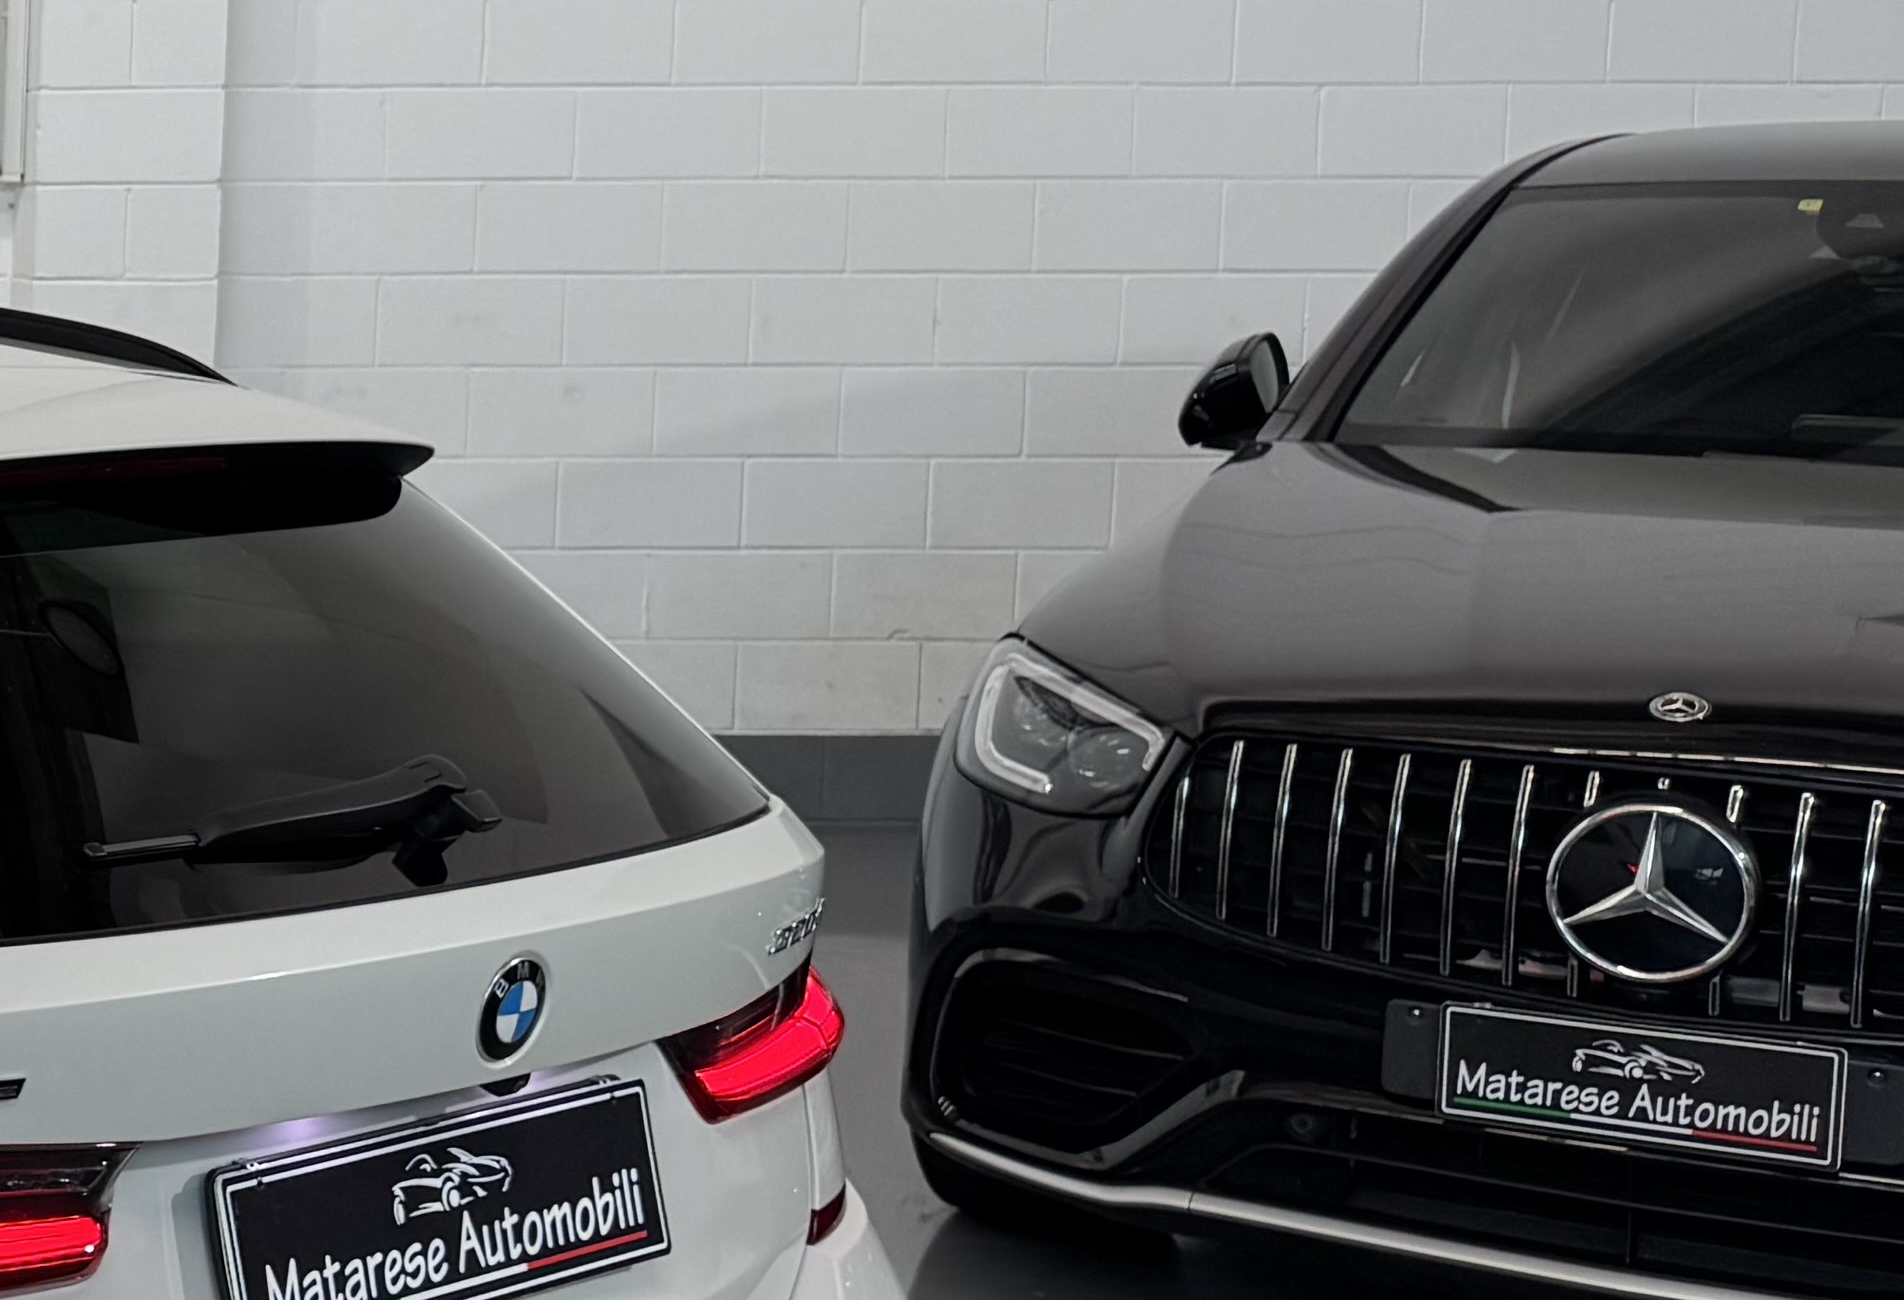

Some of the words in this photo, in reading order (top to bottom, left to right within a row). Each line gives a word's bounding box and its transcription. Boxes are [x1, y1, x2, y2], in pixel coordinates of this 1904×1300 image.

[1455, 1059, 1620, 1115] Matarese
[1627, 1083, 1821, 1142] Automobili
[458, 1168, 644, 1276] Automobili
